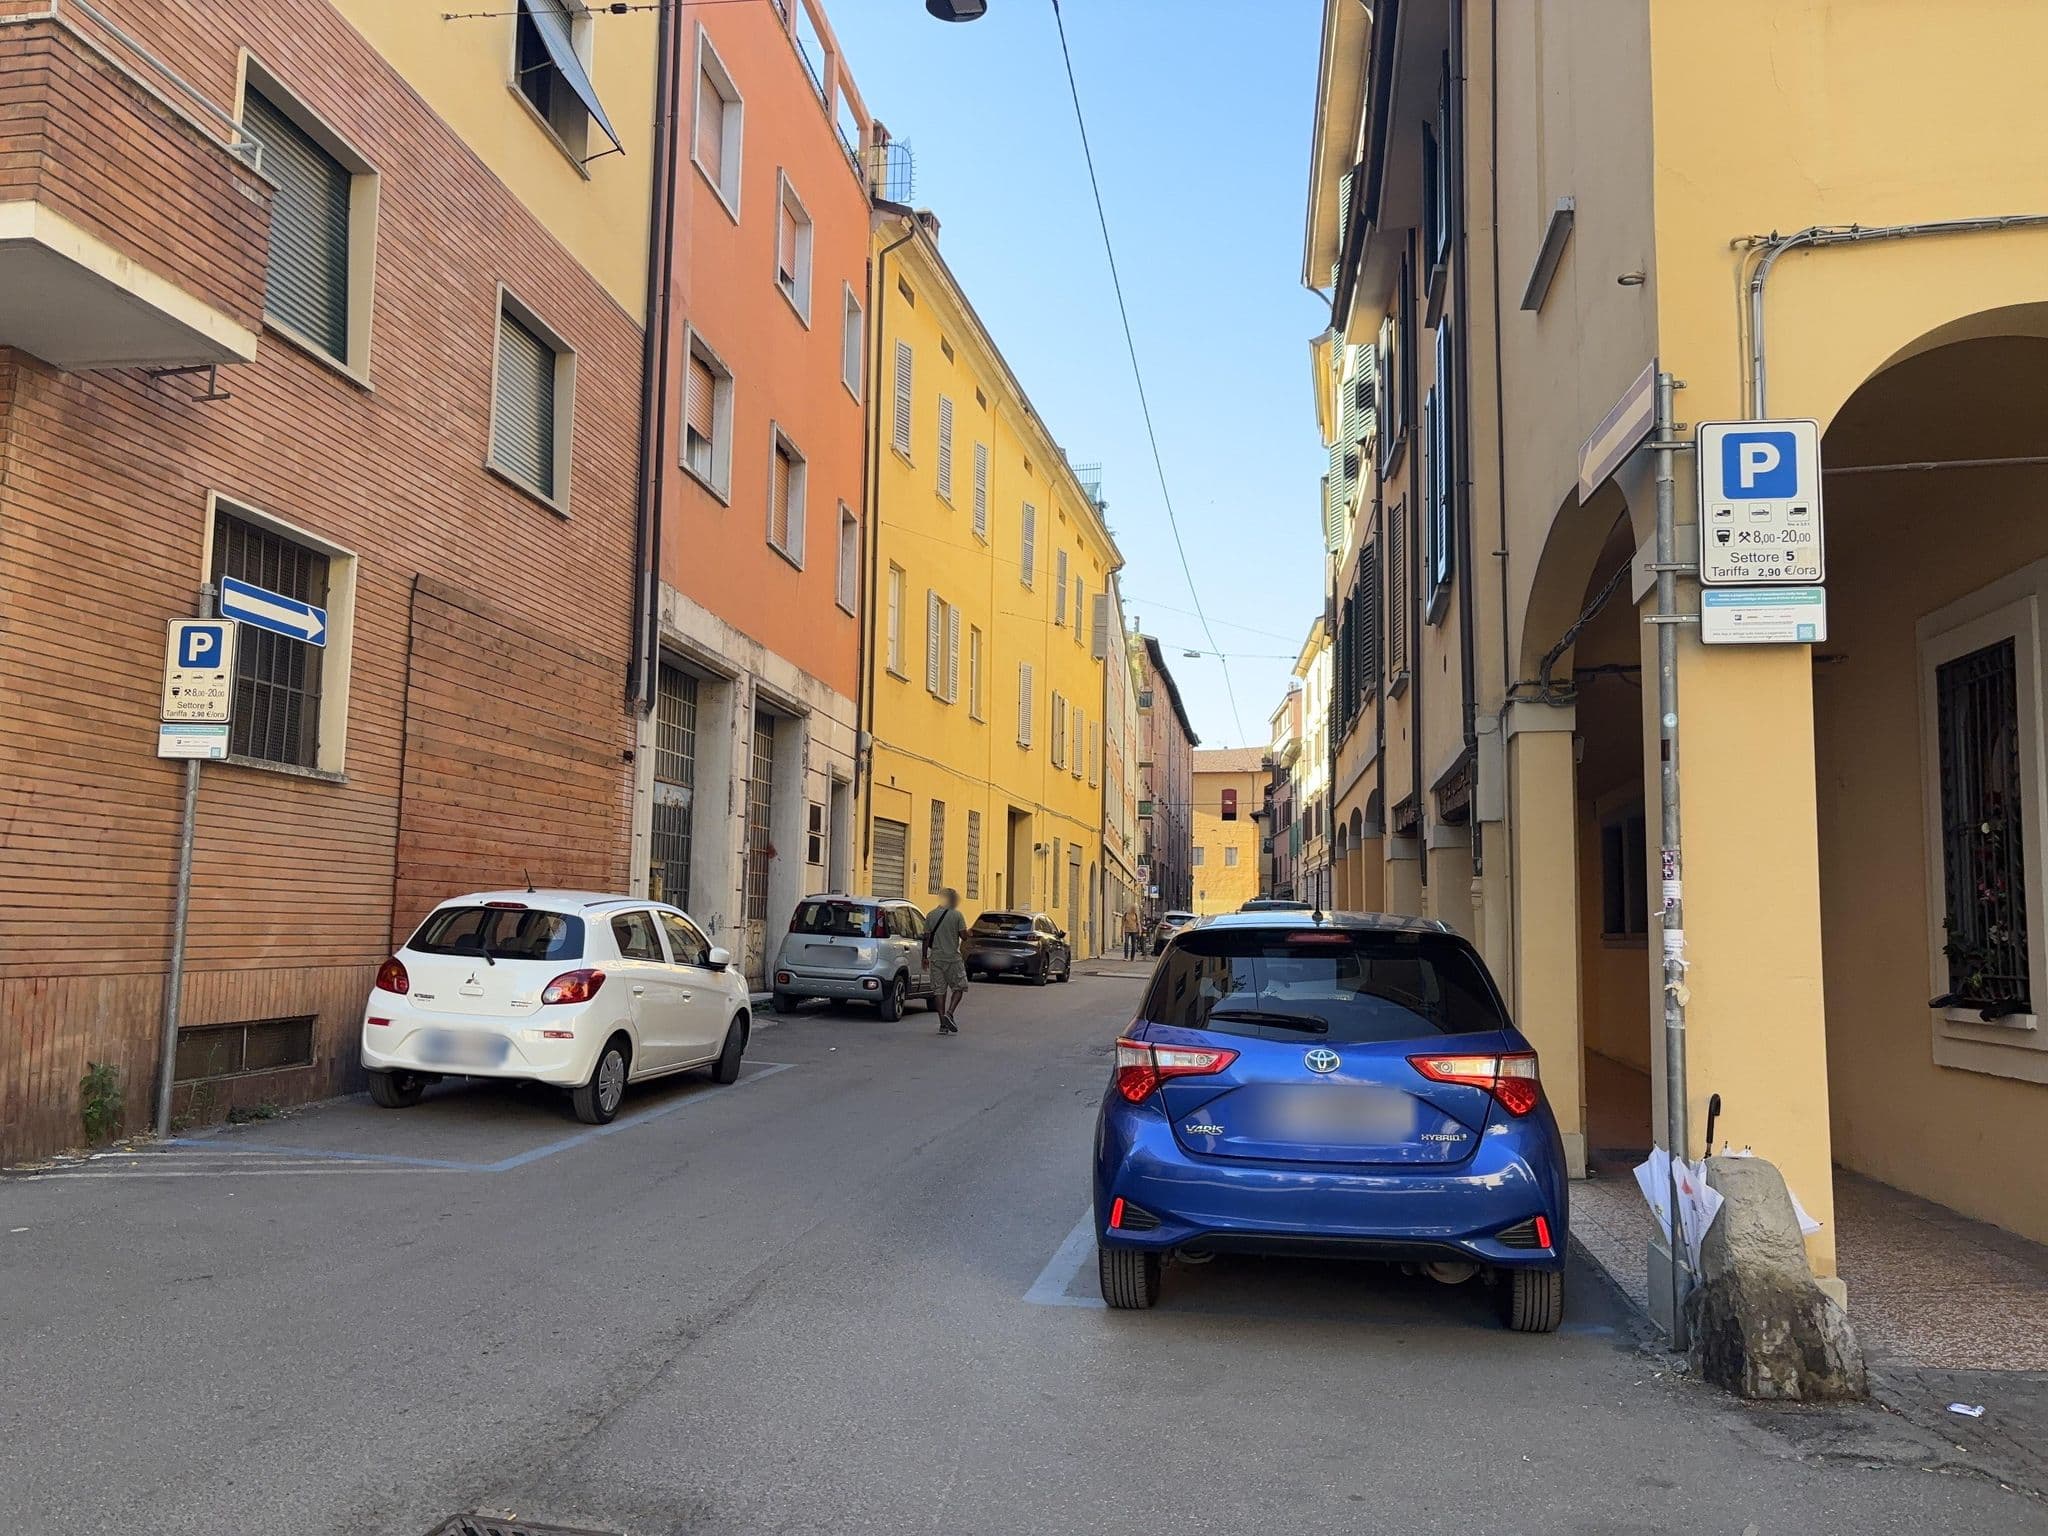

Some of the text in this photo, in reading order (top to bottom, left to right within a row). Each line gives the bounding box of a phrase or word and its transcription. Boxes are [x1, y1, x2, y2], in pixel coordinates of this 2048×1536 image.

[1740, 443, 1780, 488] P
[1730, 551, 1795, 563] Settore 5
[1711, 566, 1817, 577] Tariffa 2,90 €/ora
[188, 632, 214, 661] P
[177, 701, 206, 709] Settore
